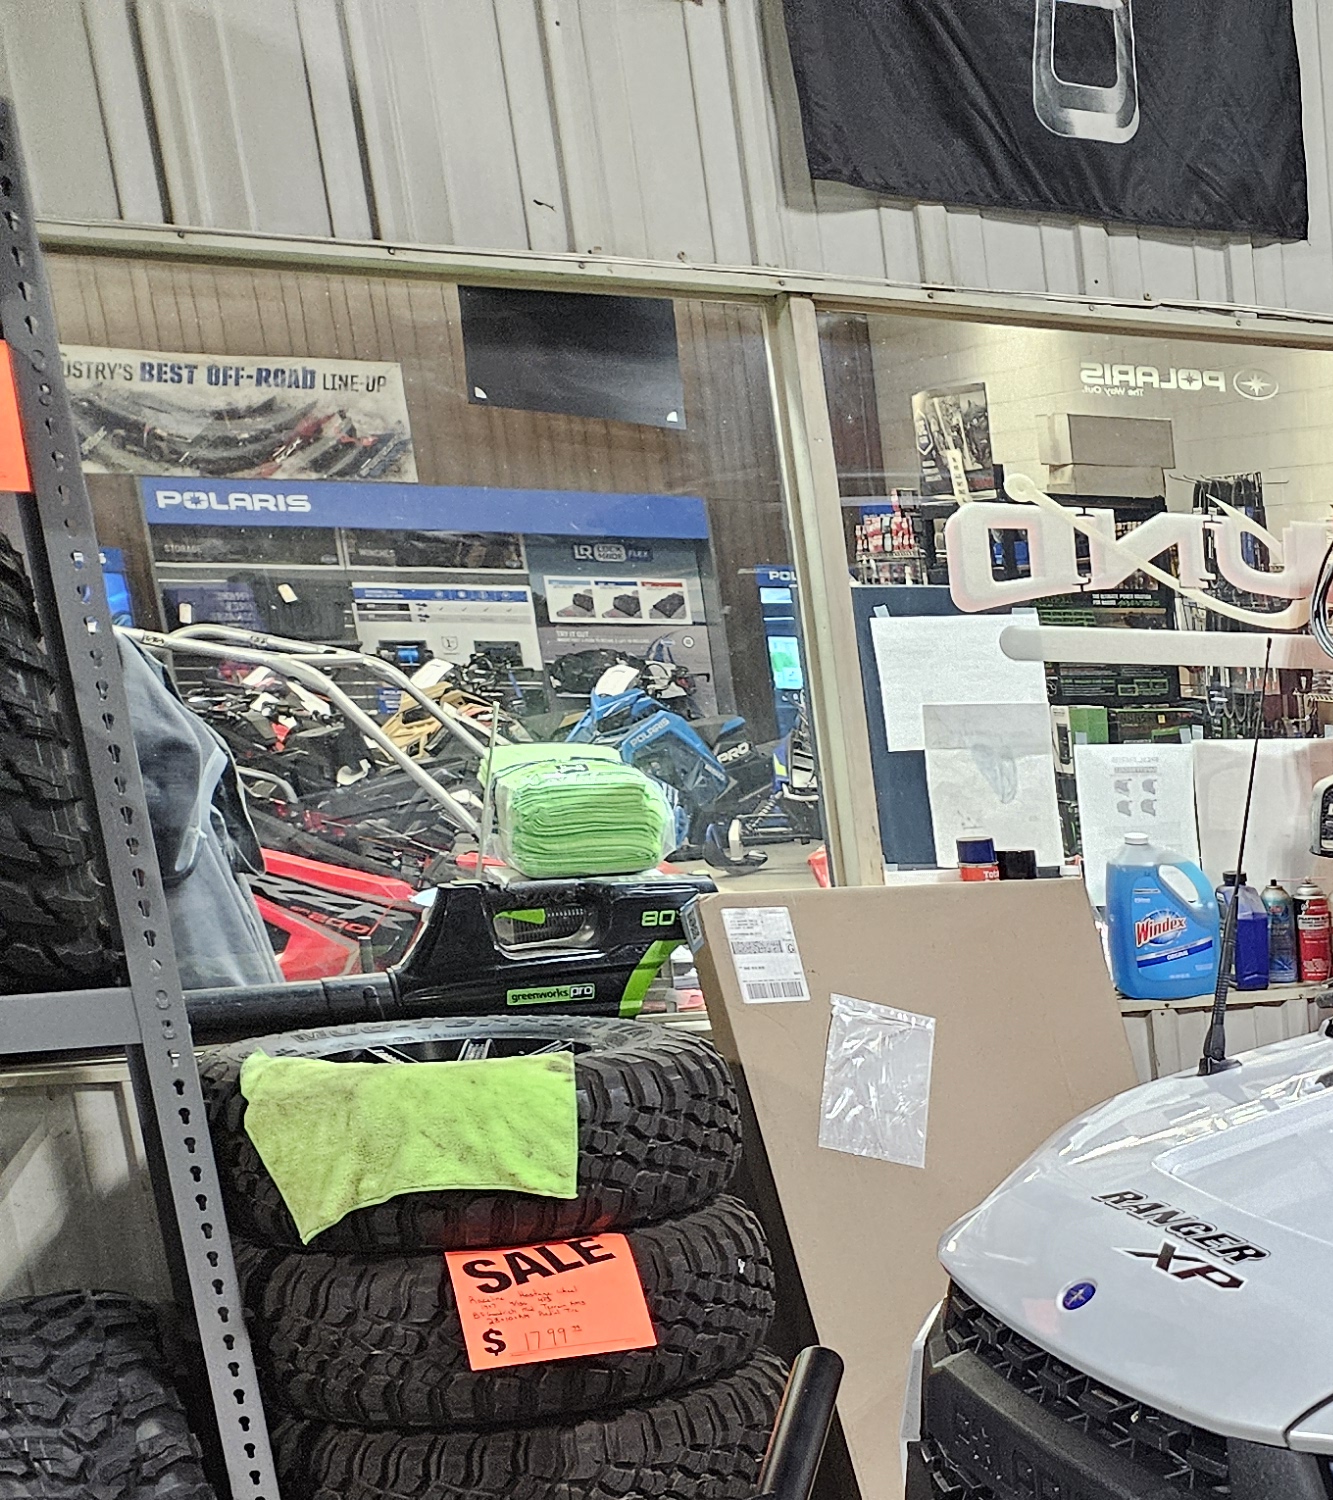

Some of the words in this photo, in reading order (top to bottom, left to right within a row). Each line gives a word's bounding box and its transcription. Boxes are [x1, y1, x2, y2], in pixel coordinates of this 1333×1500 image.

[62, 362, 134, 382] USTRY'S
[140, 361, 198, 385] BEST
[206, 364, 316, 390] OFF-ROAD
[322, 373, 387, 394] LINE-UP
[155, 490, 312, 513] POLARIS
[769, 571, 797, 581] POL
[629, 717, 670, 749] POLARIS
[717, 741, 750, 764] PRO
[1135, 917, 1187, 948] Windex
[511, 988, 569, 1003] greenworks
[570, 986, 593, 999] pro
[1091, 1188, 1272, 1266] RANGER
[462, 1237, 617, 1294] SALE
[1111, 1238, 1249, 1292] XP
[482, 1328, 507, 1357] $
[524, 1327, 568, 1351] 1799
